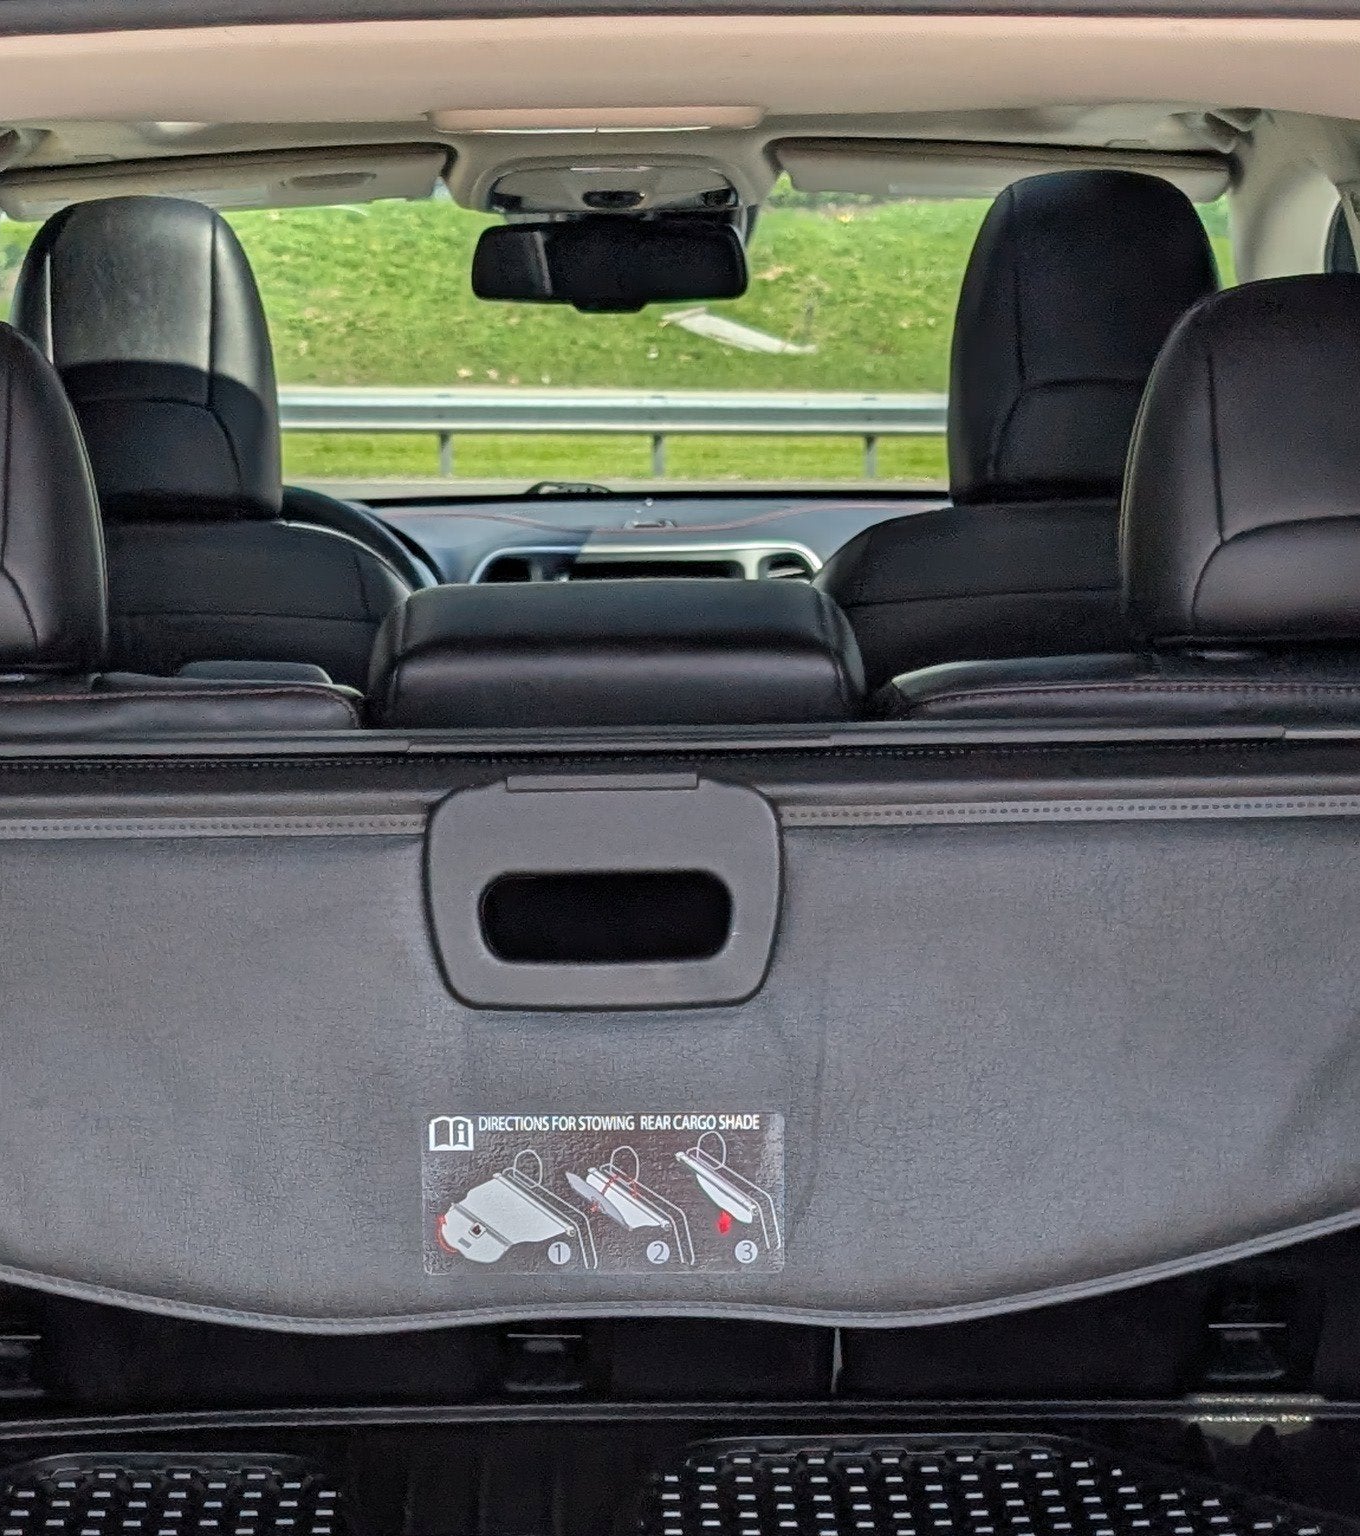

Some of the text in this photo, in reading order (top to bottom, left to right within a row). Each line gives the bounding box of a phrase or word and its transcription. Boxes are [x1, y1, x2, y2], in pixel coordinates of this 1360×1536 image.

[478, 1114, 760, 1132] DIRECTIONS FOR STOWING REAR CARGO SHADE
